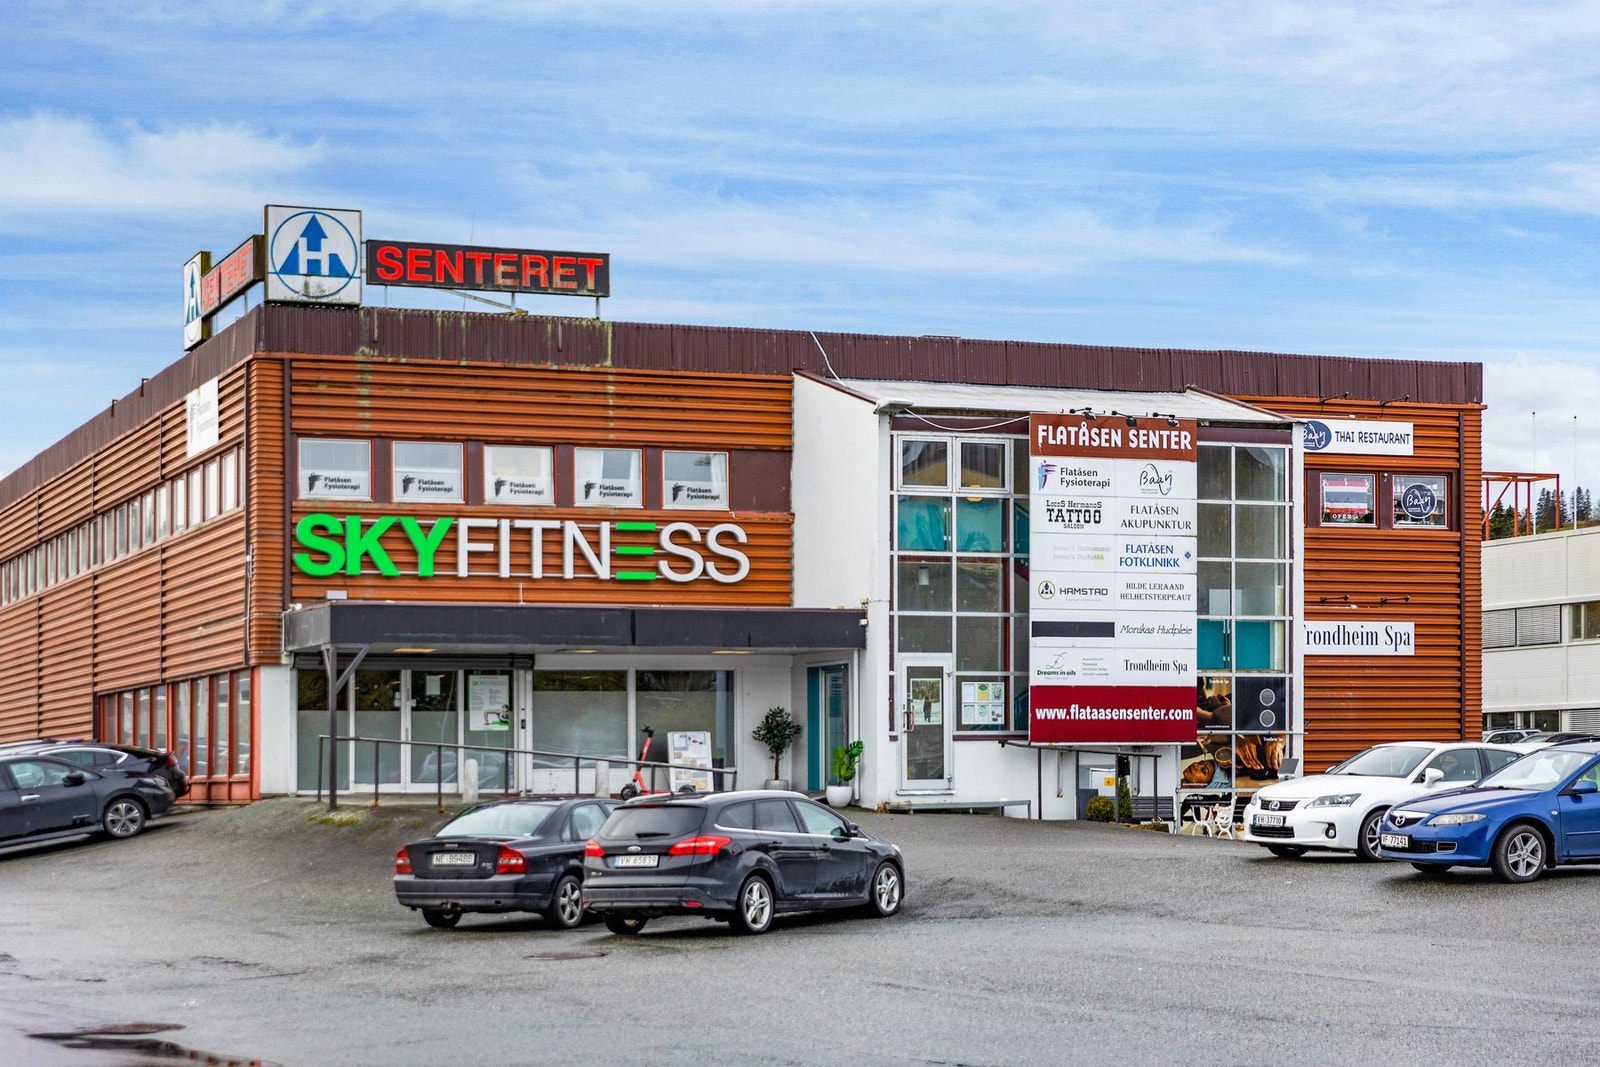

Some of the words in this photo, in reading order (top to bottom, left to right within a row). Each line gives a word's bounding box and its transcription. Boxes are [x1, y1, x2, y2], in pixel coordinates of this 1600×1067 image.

[376, 246, 603, 291] SENTERET
[1038, 421, 1122, 448] FLATÅSEN
[1129, 429, 1192, 450] SENTER
[1335, 431, 1355, 443] THAI
[1358, 431, 1410, 445] RESTAURANT
[1060, 467, 1098, 477] Flatåsen
[1060, 478, 1110, 489] Fysioterapi
[509, 488, 544, 496] Fysioterapi
[599, 490, 633, 498] Fysioterapi
[686, 493, 720, 501] Fysioterapi
[1130, 503, 1179, 515] FLATÅSEN
[1046, 508, 1102, 524] TATTOO
[1120, 519, 1192, 530] AKUPUNKTUR
[294, 513, 750, 583] SKYFITNESS
[1125, 542, 1174, 554] FLATÅSEN
[1119, 557, 1180, 568] FOTKLINIKK
[1059, 588, 1109, 596] HAMSTAD
[1120, 624, 1155, 634] Monikas
[1157, 624, 1193, 636] Hudpleie
[1303, 624, 1379, 646] rondheim
[1384, 625, 1411, 652] Spa
[1124, 659, 1170, 671] Trondheim
[1172, 660, 1188, 675] Spa
[1035, 704, 1193, 720] www.flataasensenter.com
